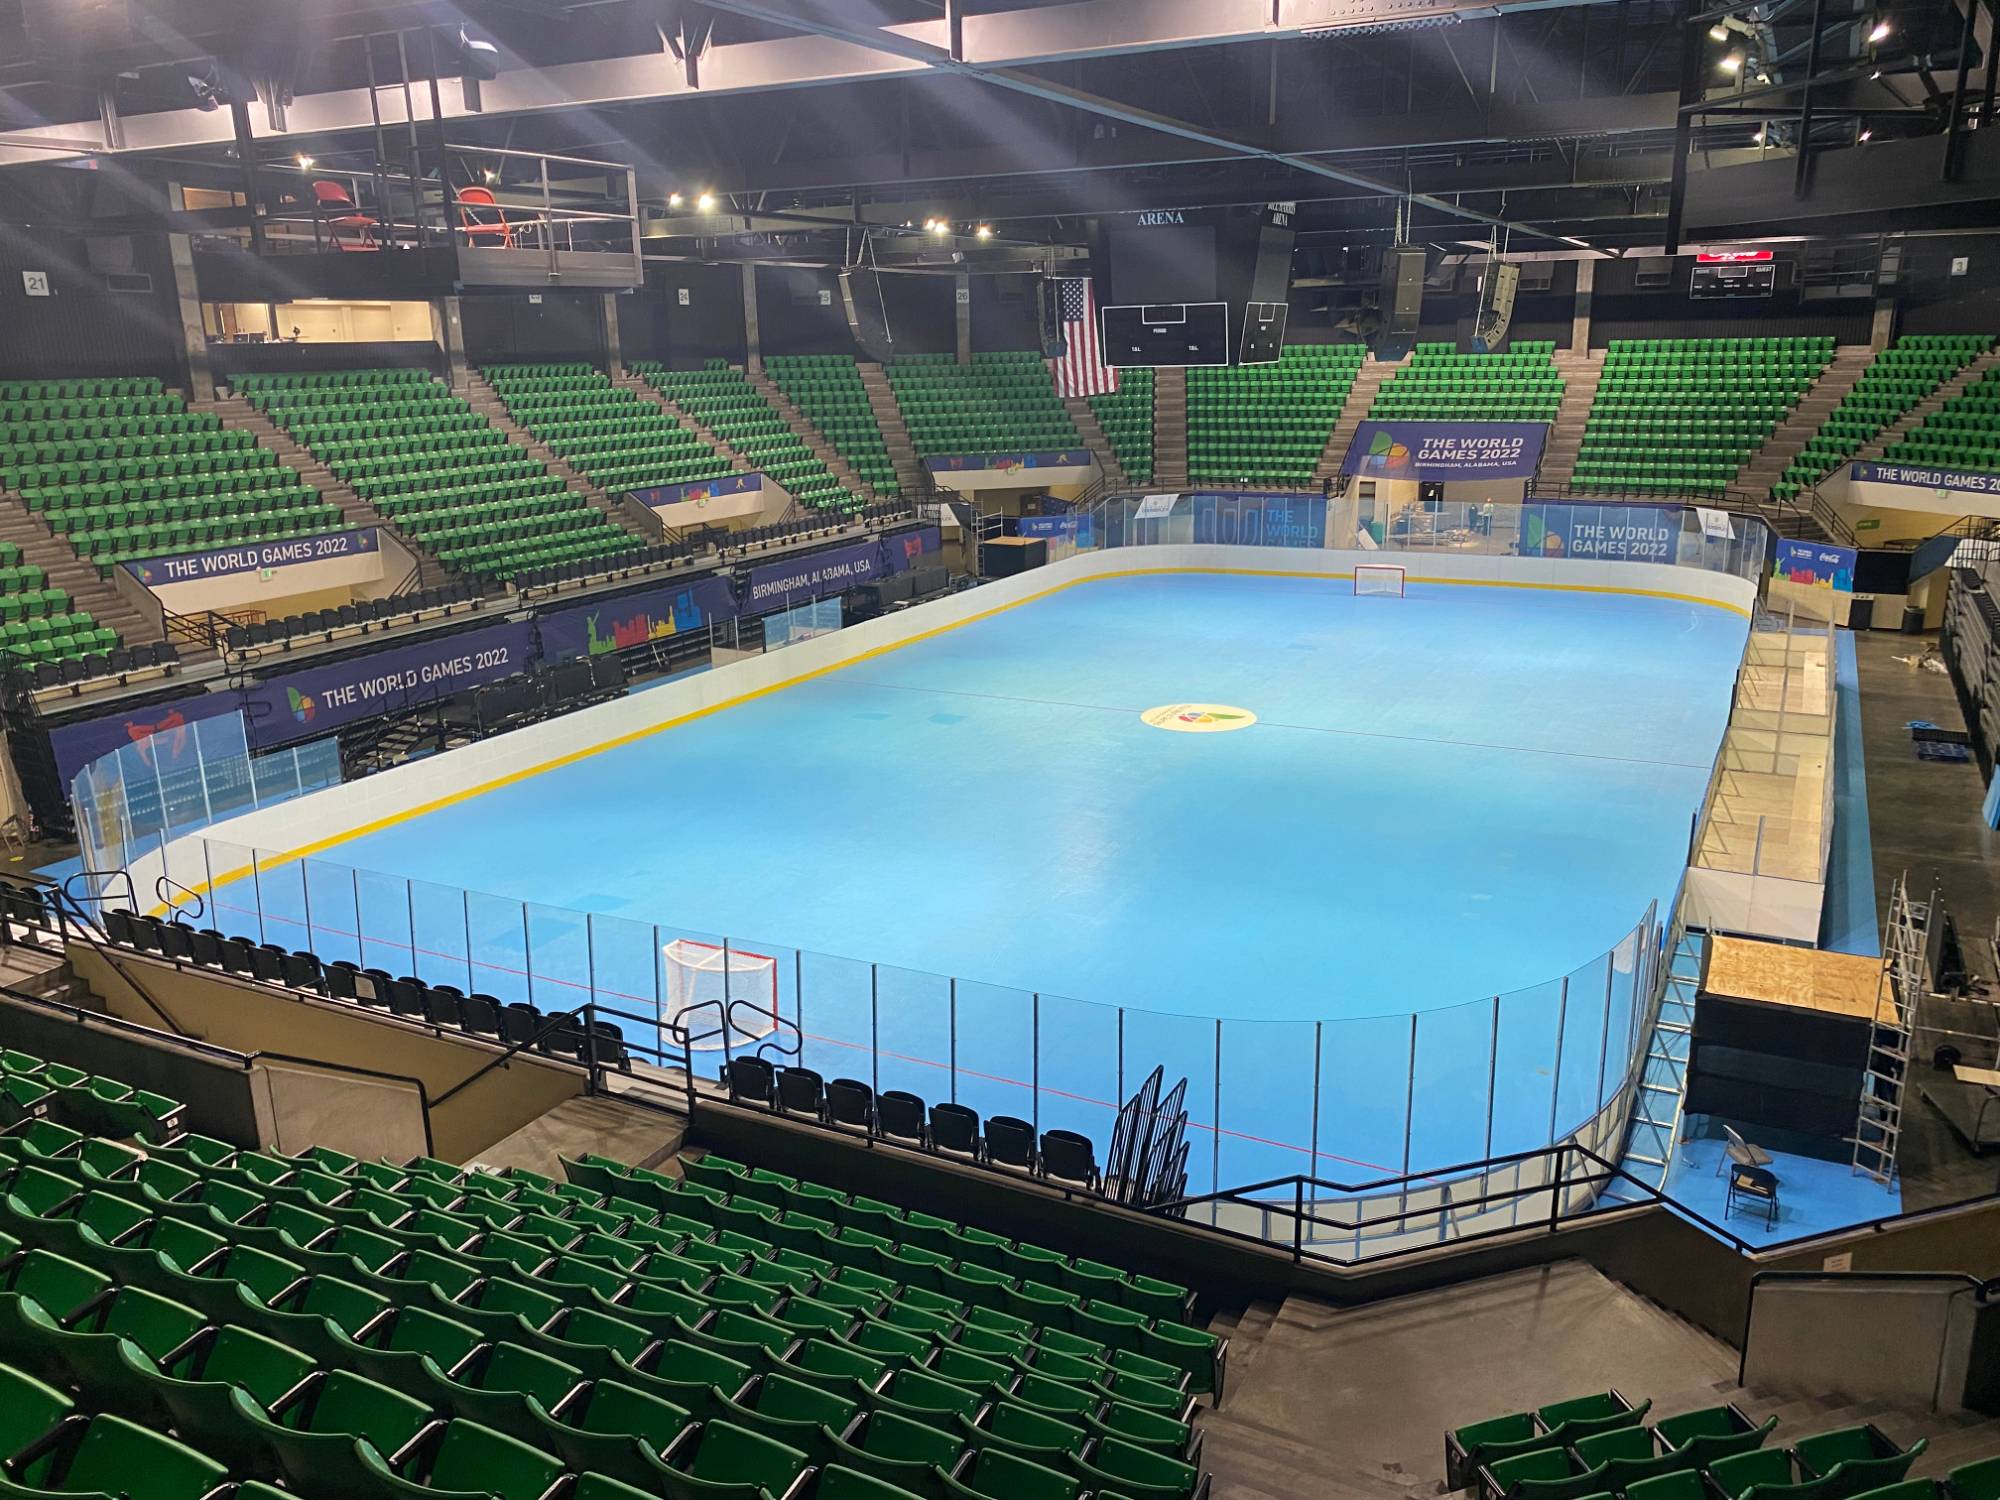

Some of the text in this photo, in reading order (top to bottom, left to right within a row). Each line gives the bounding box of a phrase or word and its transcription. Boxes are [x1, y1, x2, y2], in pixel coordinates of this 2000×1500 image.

[1137, 212, 1185, 226] ARENA
[1272, 213, 1288, 226] ARENA
[1956, 261, 1964, 271] 3
[28, 277, 45, 290] 21
[958, 291, 968, 301] 26
[1423, 437, 1524, 449] THE WORLD
[1418, 448, 1521, 460] GAMES 2022
[1876, 467, 1898, 480] THE
[1900, 470, 1941, 485] WORLD
[1944, 474, 1986, 489] GAMES
[1267, 509, 1294, 522] THE
[1266, 525, 1318, 538] WORLD
[1574, 525, 1669, 541] THE WORLD
[1572, 539, 1668, 556] GAMES 2022
[164, 537, 348, 578] THE WORLD GAMES 2022
[753, 573, 810, 600] BIRMINGHAM,
[854, 559, 871, 574] USA
[321, 647, 509, 709] THE WORLD GAMES 2022
